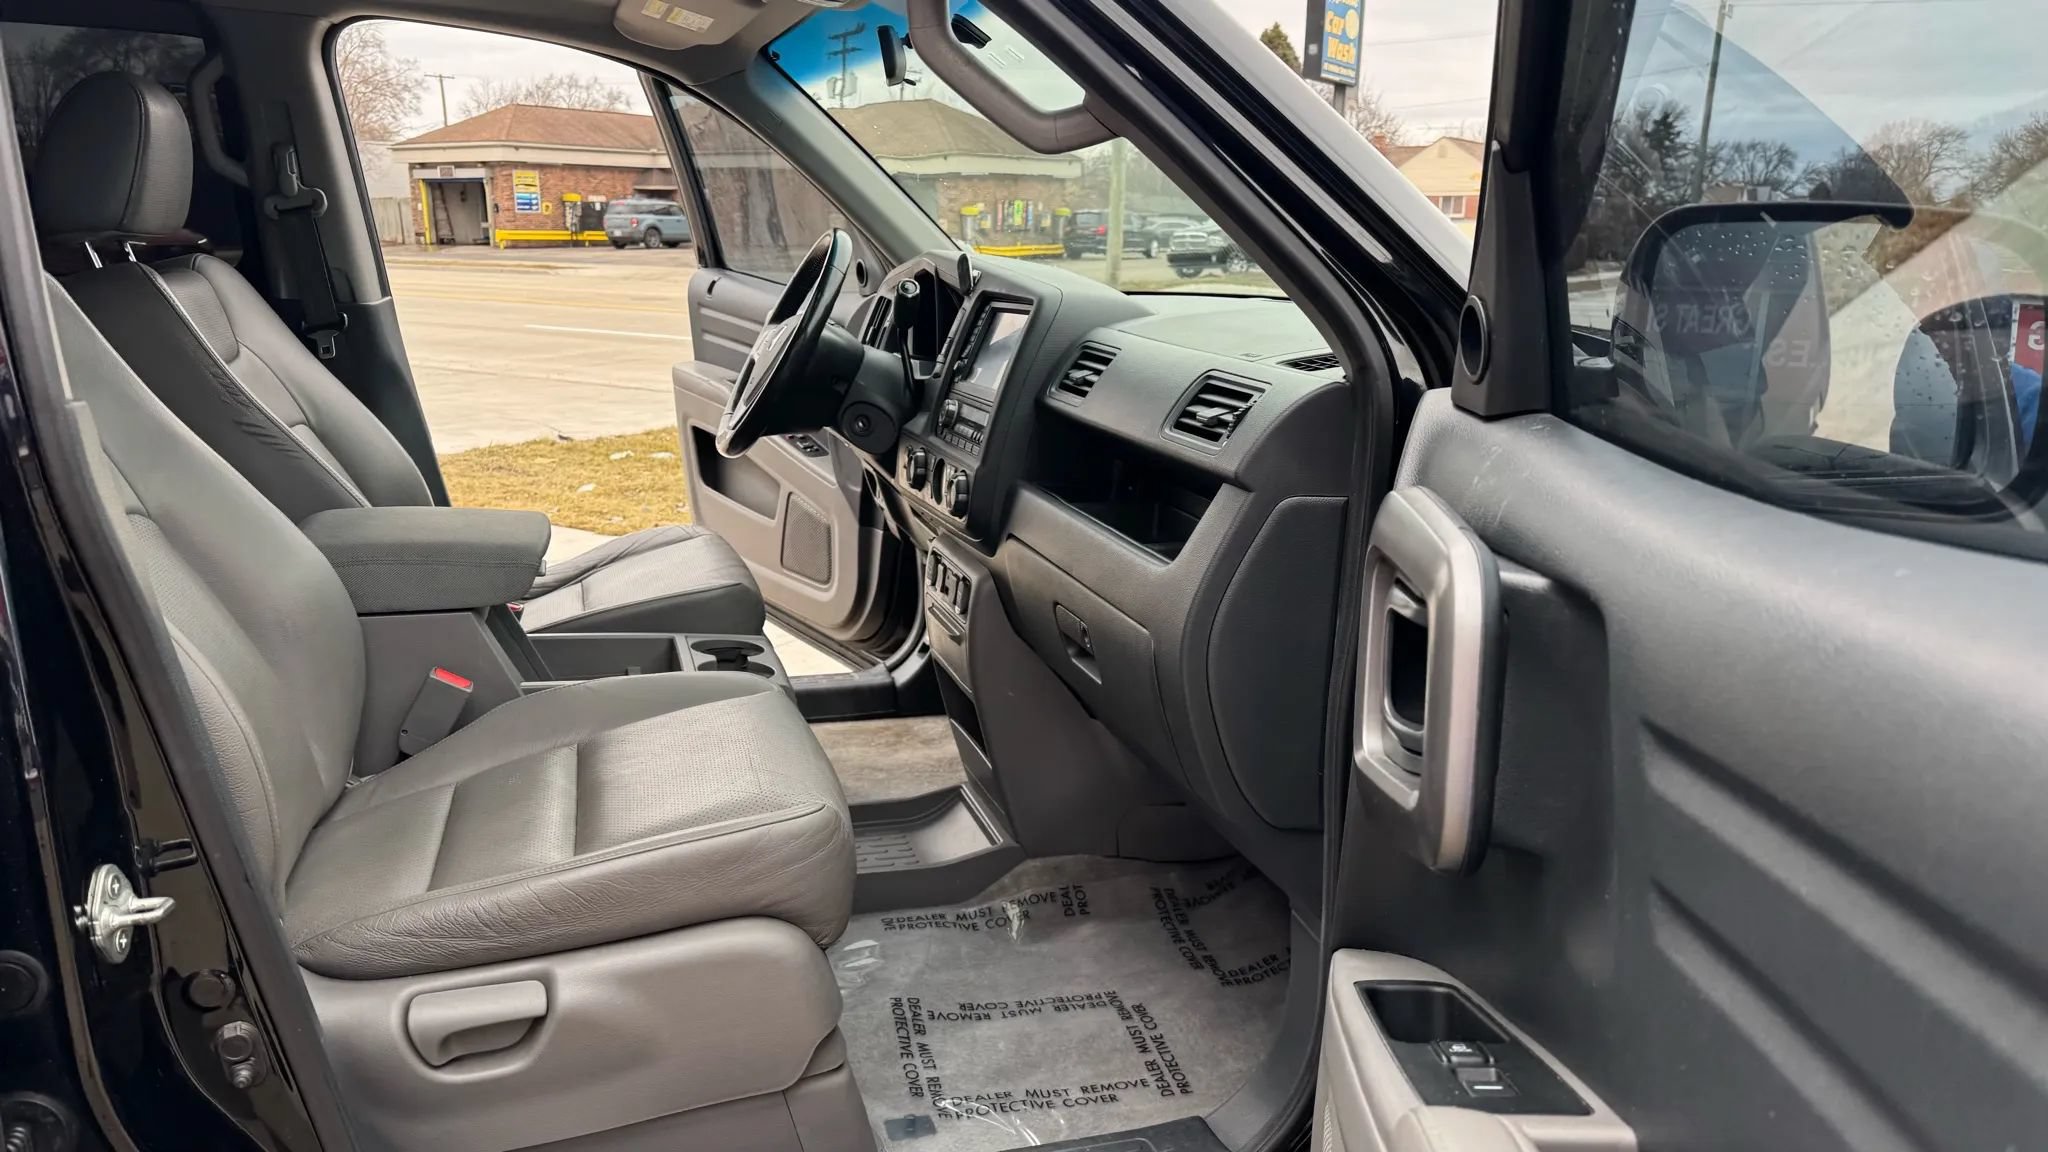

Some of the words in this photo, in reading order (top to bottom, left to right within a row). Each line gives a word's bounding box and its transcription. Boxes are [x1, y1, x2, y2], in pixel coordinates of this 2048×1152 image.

[1327, 36, 1356, 65] Wash
[896, 912, 946, 923] DEALER
[956, 907, 993, 921] MUST
[899, 920, 980, 932] PROTECTIVE
[985, 909, 1031, 930] COVER
[1149, 886, 1186, 945] PROTECTIVE
[1179, 945, 1205, 970] COVER
[1163, 888, 1189, 925] DEALER
[1184, 929, 1208, 952] MUST
[1202, 954, 1234, 987] REMOVE
[1228, 954, 1280, 978] DEALER
[959, 1002, 1009, 1011] COVER
[1000, 1007, 1042, 1020] MUST
[1015, 992, 1102, 1008] PROTECTIVE
[1053, 1001, 1108, 1013] DEALER
[1103, 990, 1133, 1020] REMOVE
[907, 997, 927, 1036] DEALER
[927, 1010, 992, 1022] REMOVE
[1131, 1003, 1158, 1031] COVER
[889, 997, 914, 1060] PROTECTIVE
[903, 1063, 925, 1098] COVER
[1126, 1025, 1152, 1054] MUST
[916, 1042, 937, 1070] MUST
[1149, 1033, 1194, 1095] PROTECTIVE
[1144, 1059, 1175, 1097] DEALER
[925, 1076, 953, 1119] REMOVE
[952, 1091, 1013, 1107] DEALER
[1025, 1088, 1070, 1099] MUST
[1080, 1078, 1150, 1095] REMOVE
[955, 1099, 1056, 1121] PROTECTIVE
[1062, 1094, 1119, 1108] COVER
